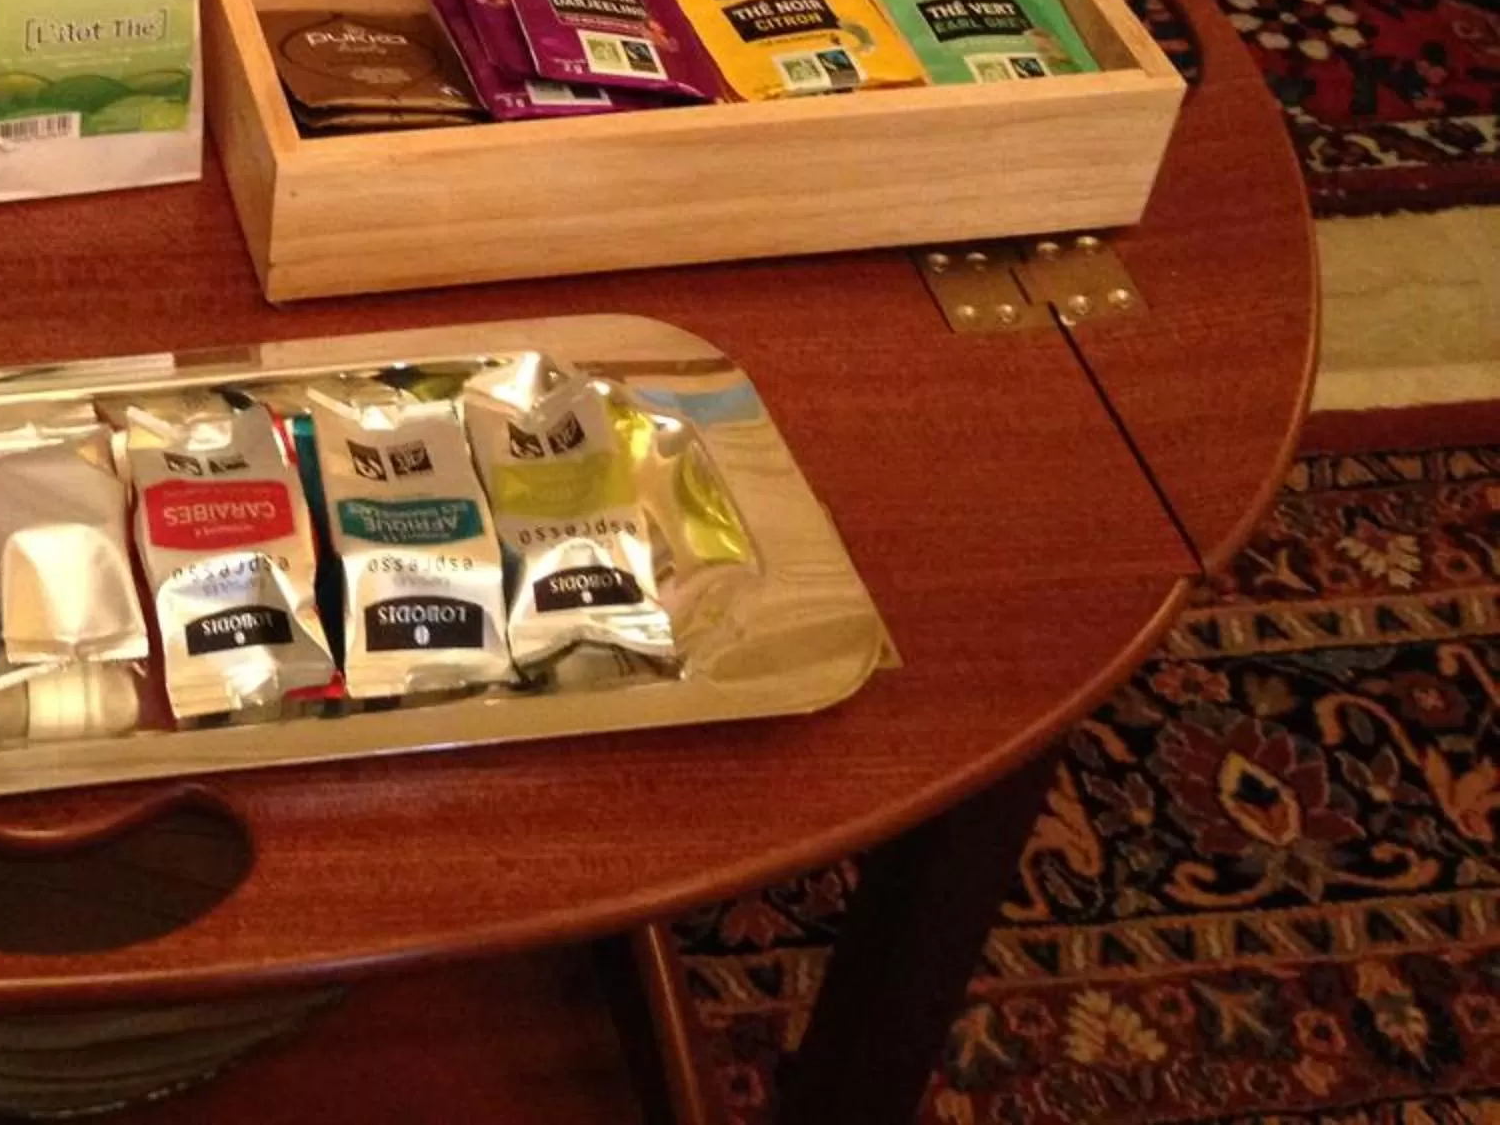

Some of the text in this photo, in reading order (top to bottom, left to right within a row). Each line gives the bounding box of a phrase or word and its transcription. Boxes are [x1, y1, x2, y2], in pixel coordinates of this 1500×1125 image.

[732, 1, 773, 20] THÉ
[968, 2, 1016, 15] VERT
[754, 13, 823, 32] CITRON
[517, 519, 638, 547] espresso
[366, 555, 474, 573] espresso
[549, 572, 622, 594] LOBODIS
[201, 612, 274, 636] LOBODIS
[377, 605, 467, 625] LOBODIS
